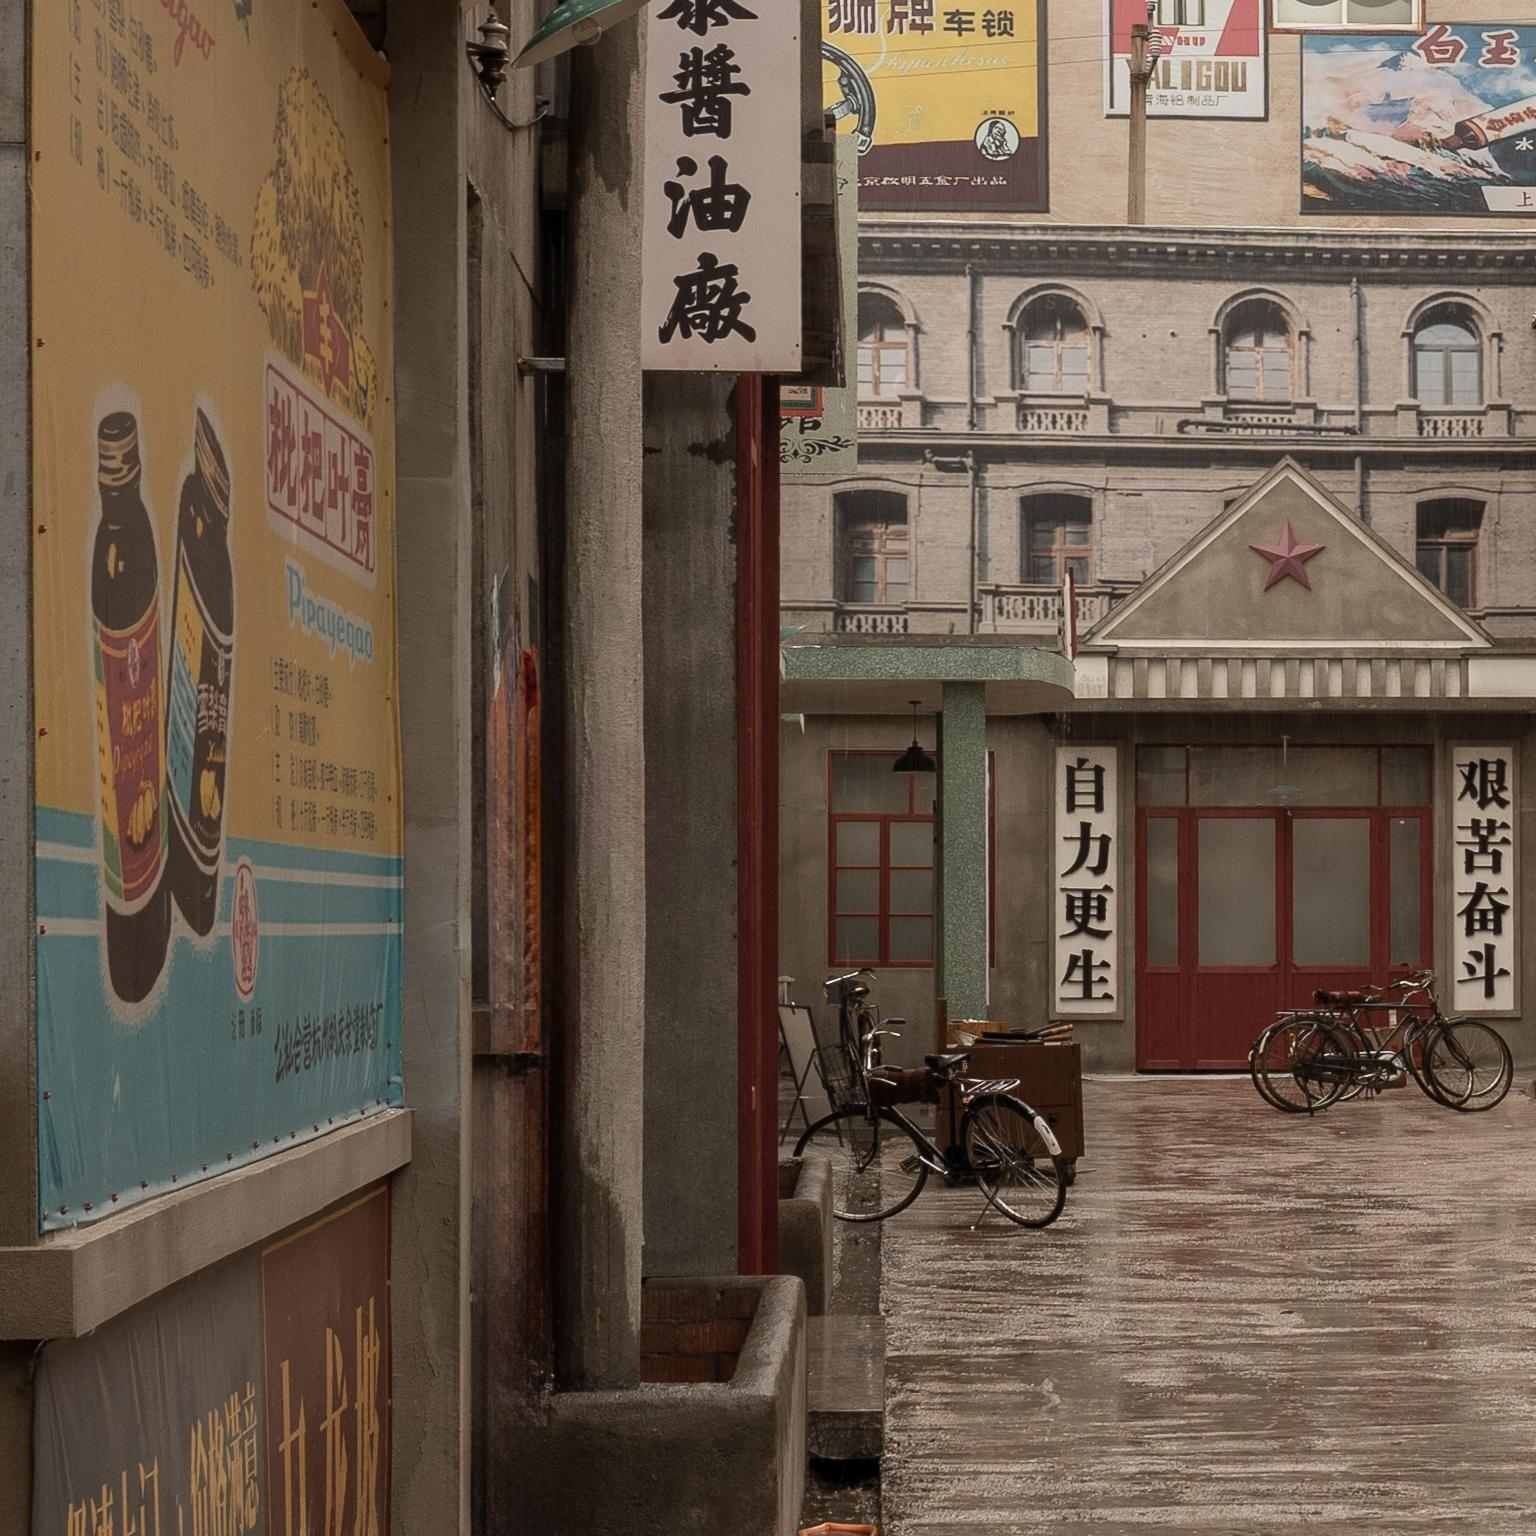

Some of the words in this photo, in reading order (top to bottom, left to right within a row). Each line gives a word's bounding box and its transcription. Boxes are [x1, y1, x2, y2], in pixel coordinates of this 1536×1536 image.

[1127, 59, 1248, 92] ALIGOU
[1059, 757, 1115, 1004] 自力更生
[1455, 757, 1513, 1000] 艰苦奋斗
